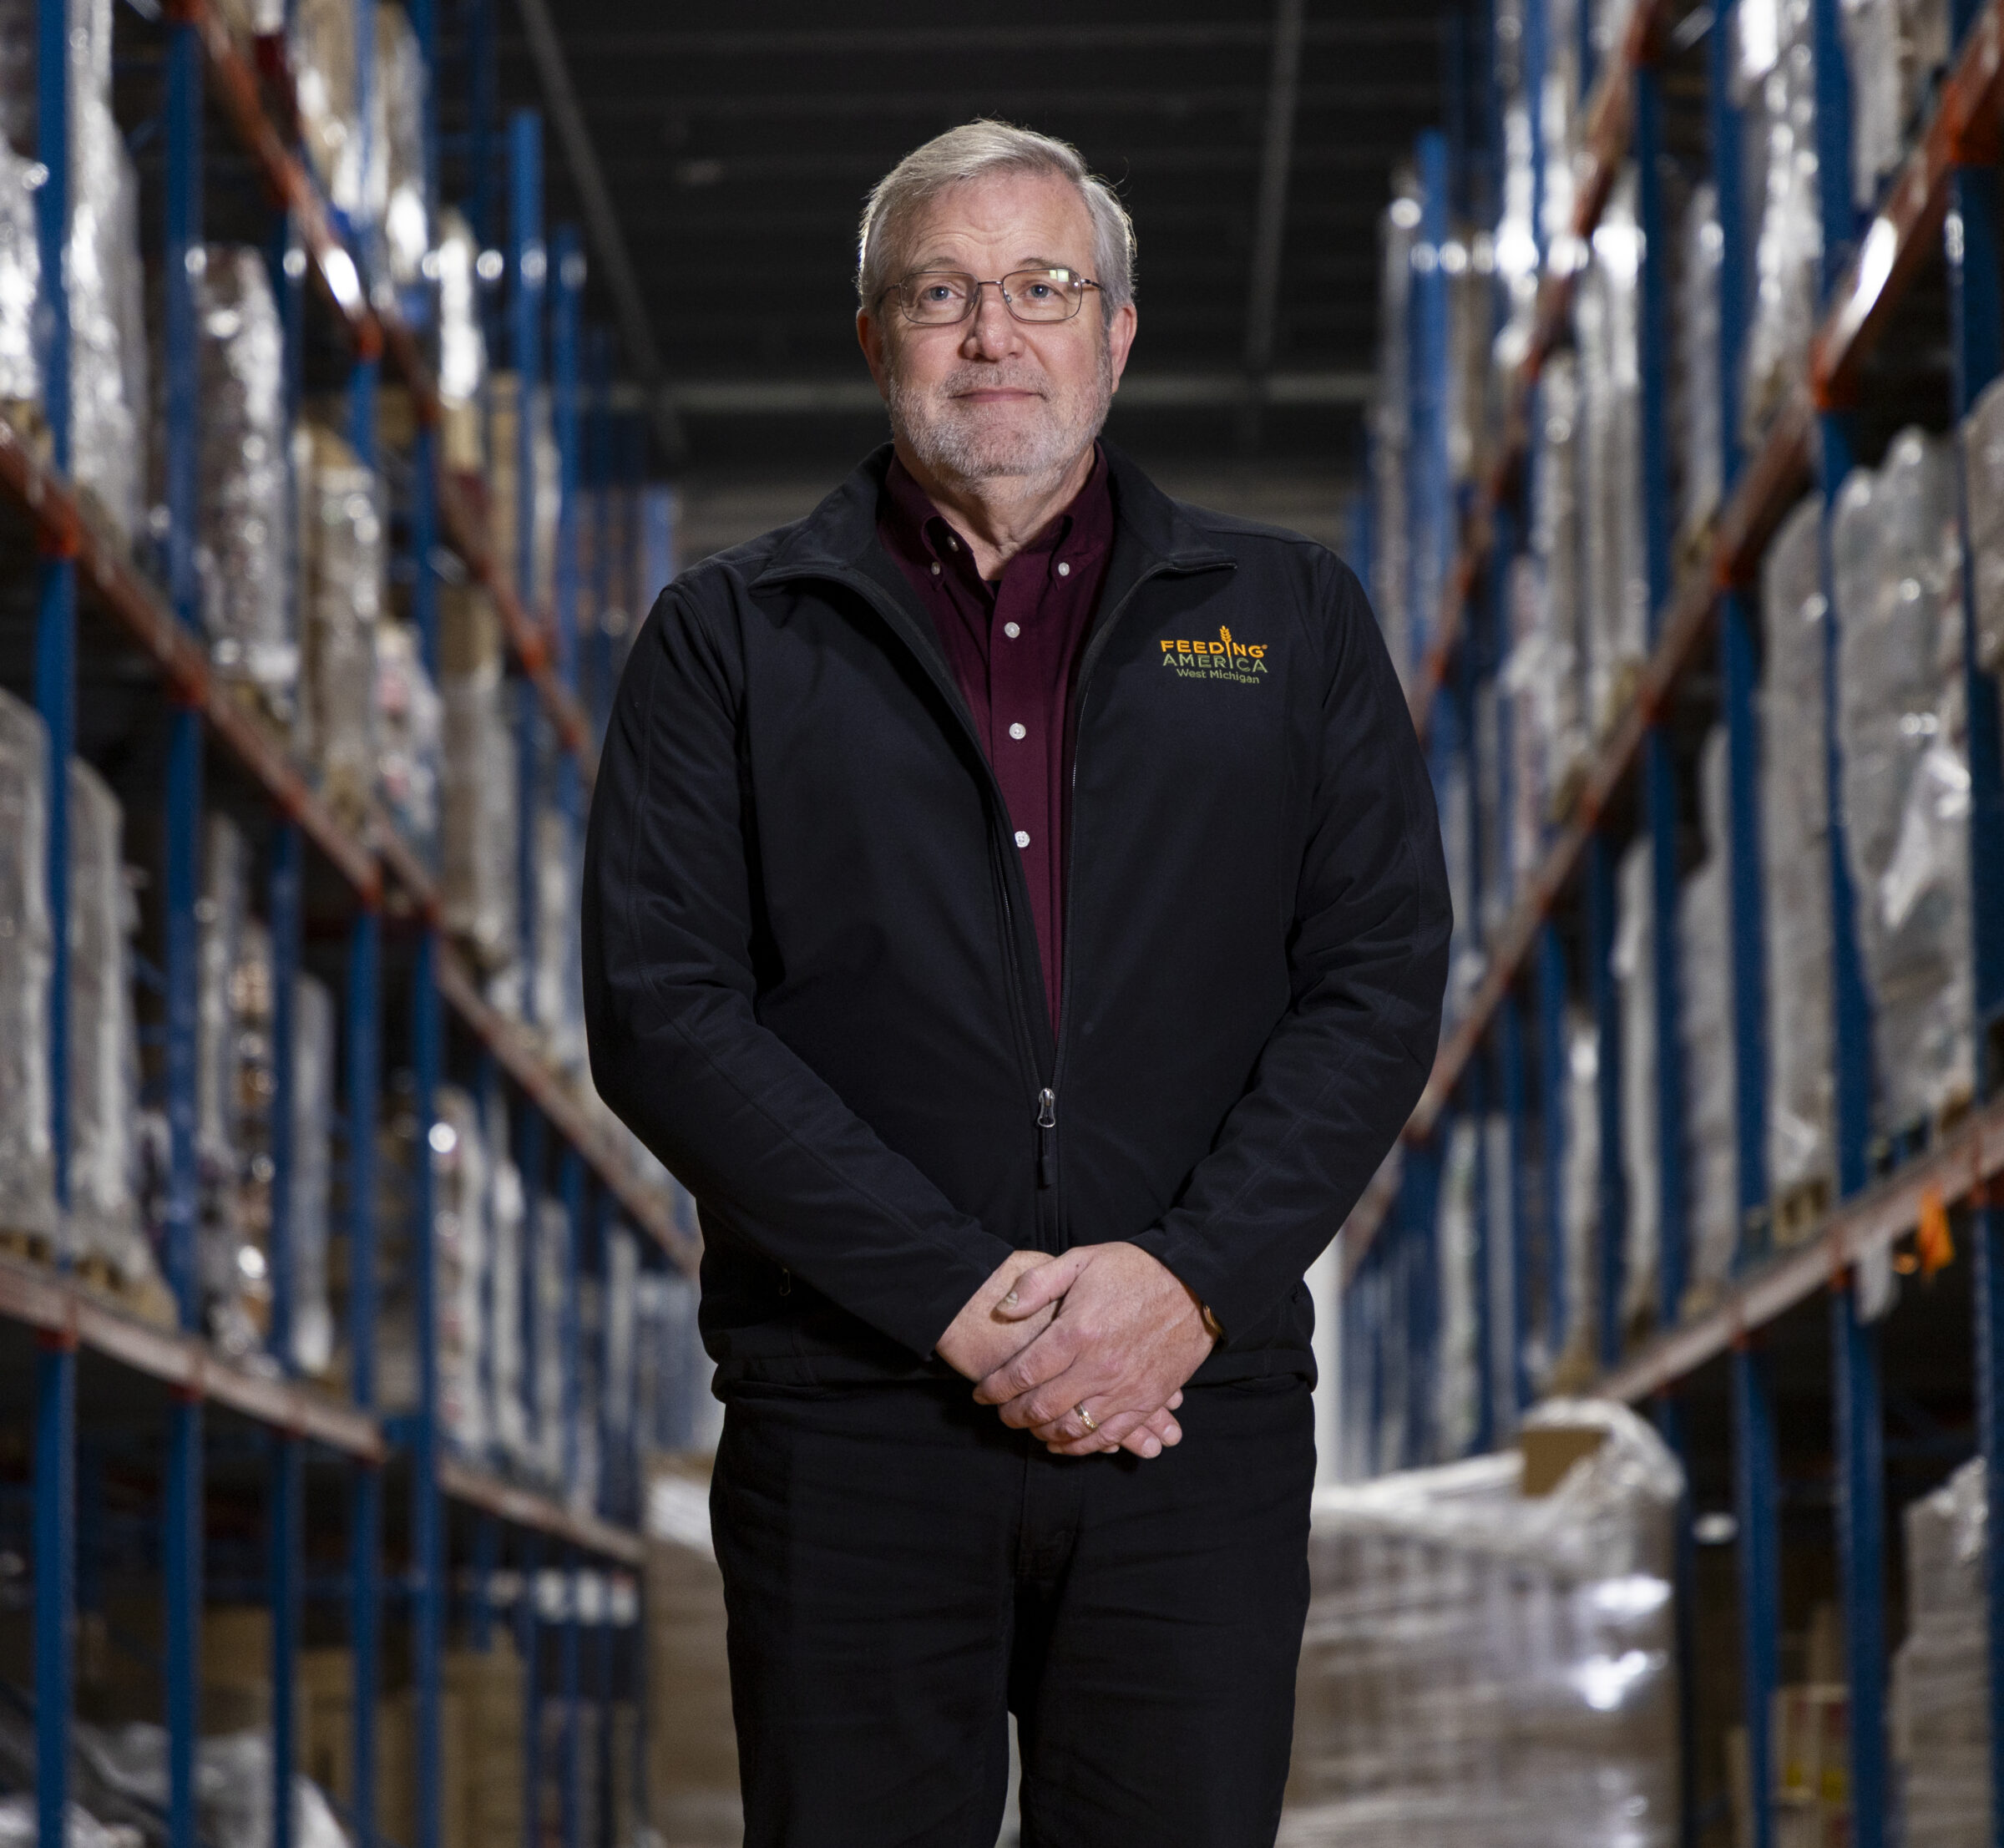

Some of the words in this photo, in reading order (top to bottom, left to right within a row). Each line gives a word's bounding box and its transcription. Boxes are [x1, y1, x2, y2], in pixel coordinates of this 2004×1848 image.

[1160, 626, 1264, 658] FEEDING
[1162, 653, 1268, 673] AMERICA
[1177, 668, 1207, 678] West
[1210, 669, 1260, 684] Michigan
